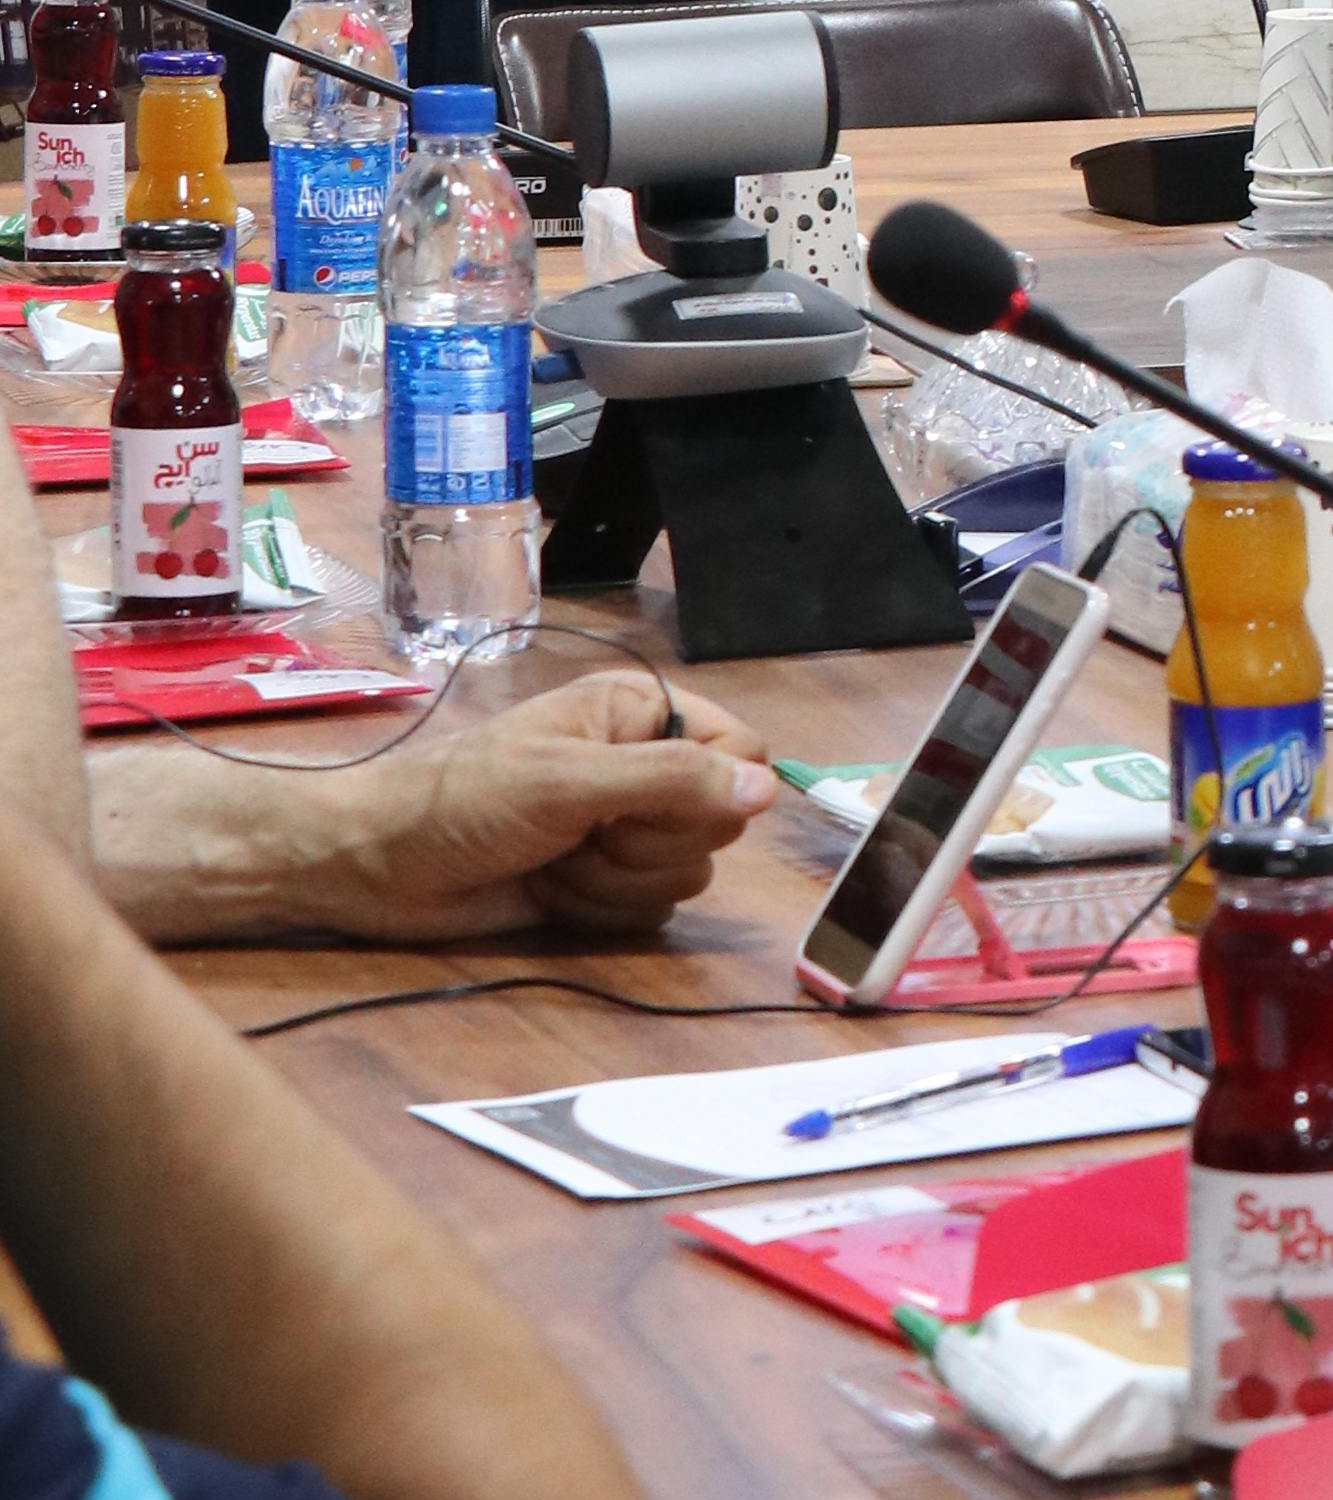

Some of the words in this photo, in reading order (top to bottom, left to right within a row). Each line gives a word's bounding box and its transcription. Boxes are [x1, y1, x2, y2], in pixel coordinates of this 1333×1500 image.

[38, 131, 73, 151] Sun
[56, 147, 86, 165] ich
[296, 173, 386, 226] AQUAFIN
[1234, 1191, 1314, 1234] Sun
